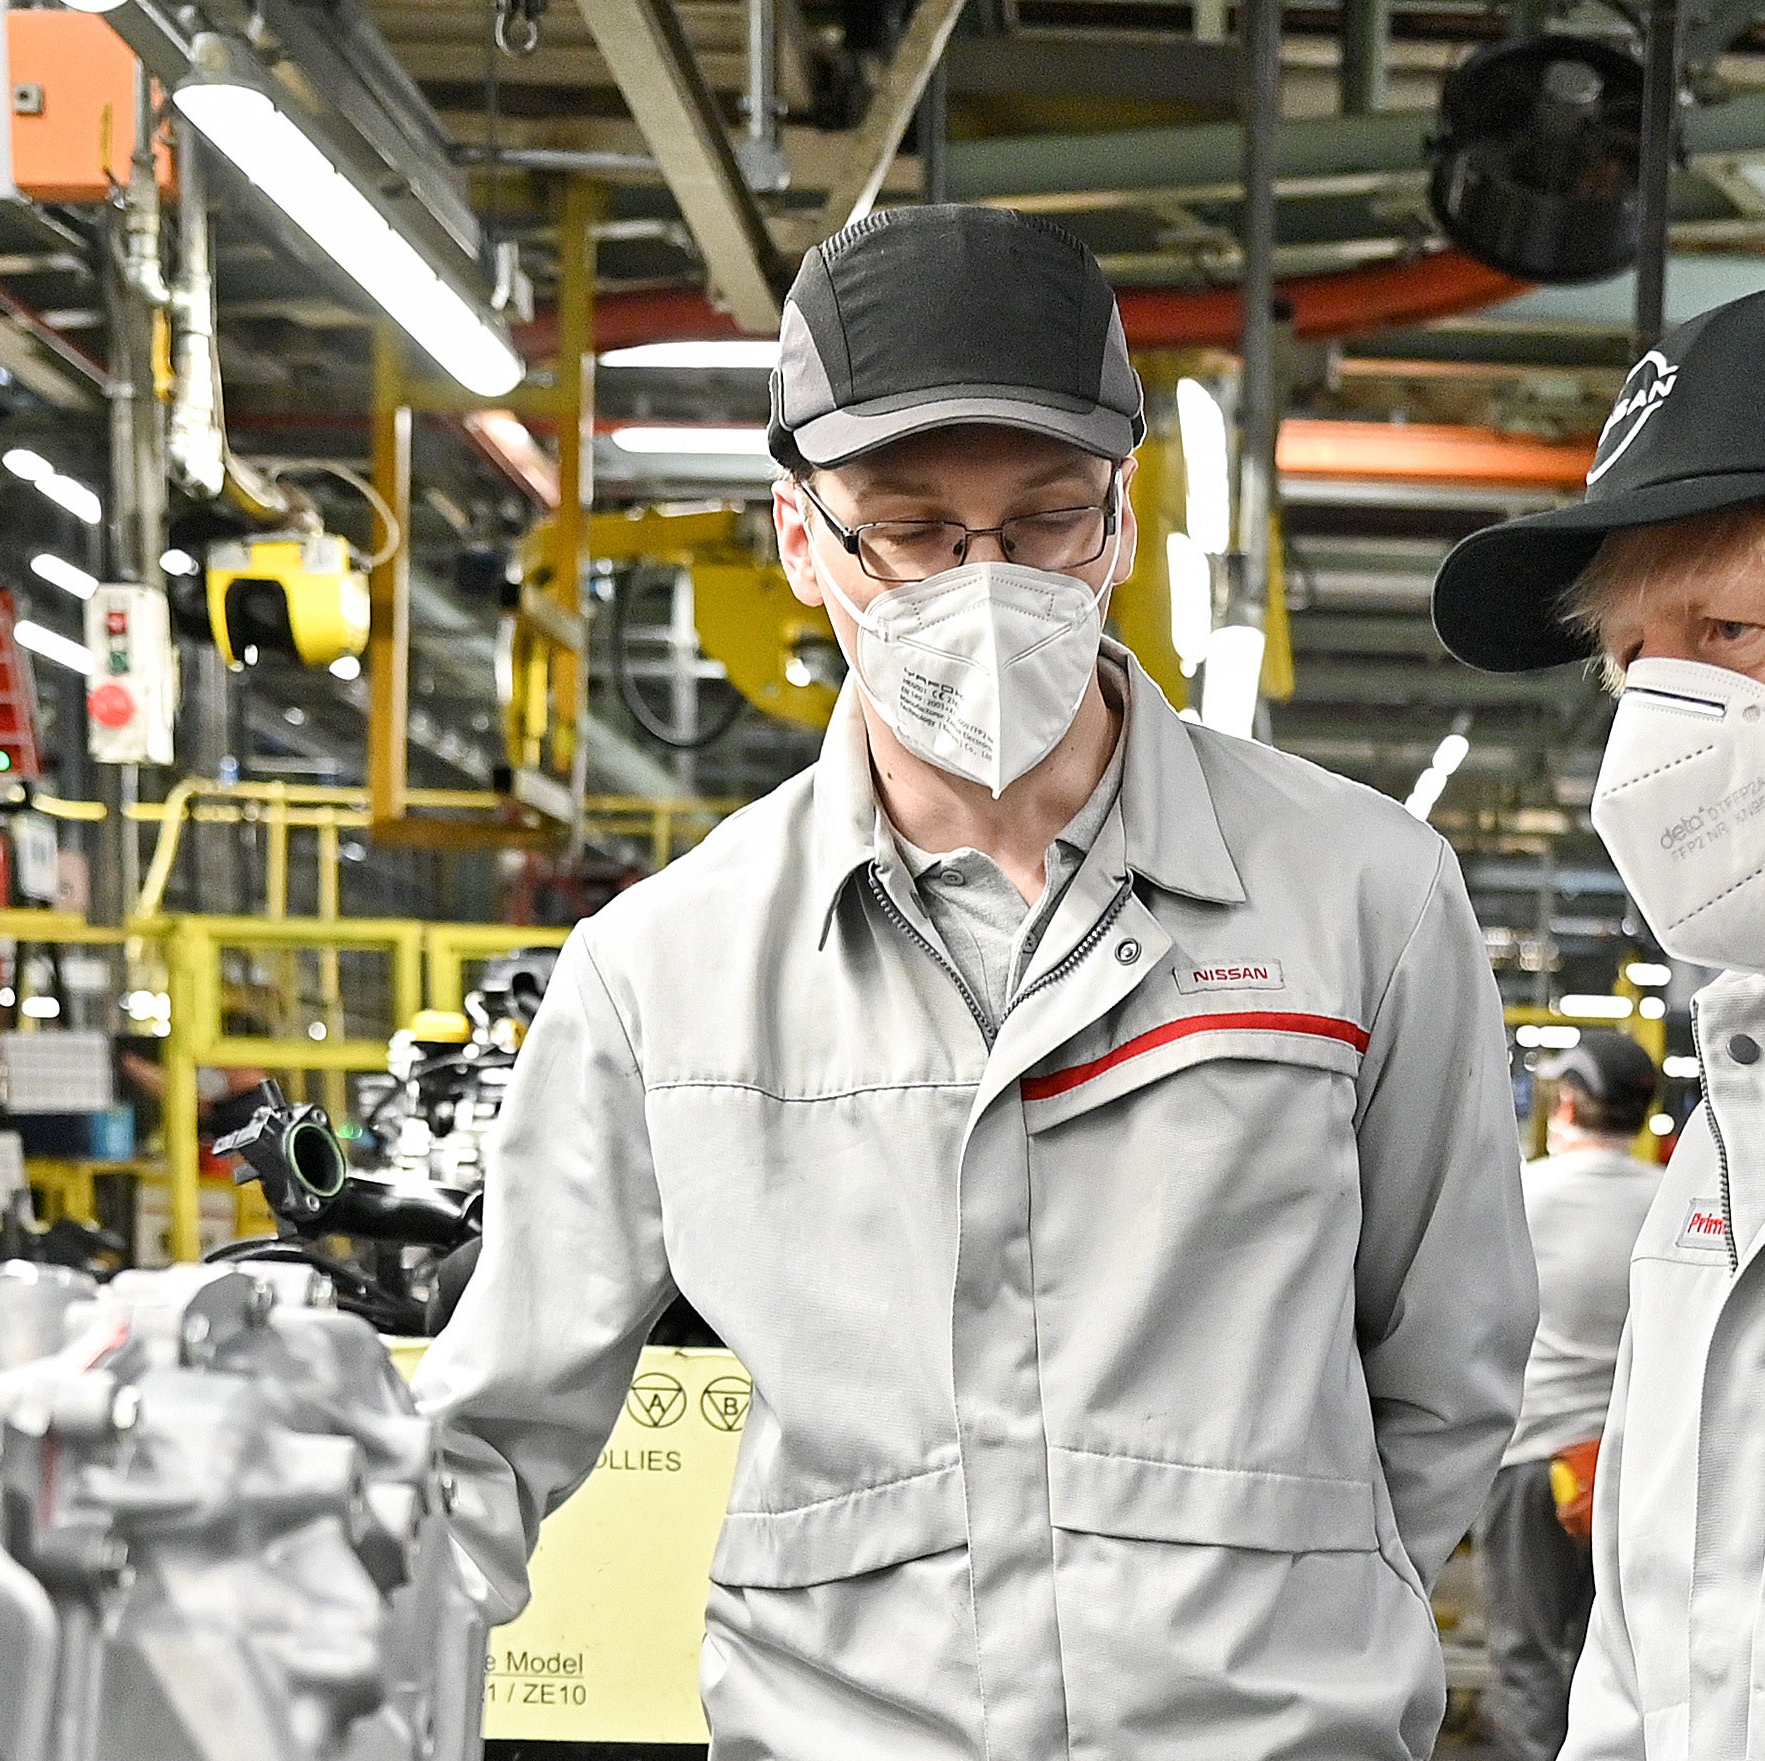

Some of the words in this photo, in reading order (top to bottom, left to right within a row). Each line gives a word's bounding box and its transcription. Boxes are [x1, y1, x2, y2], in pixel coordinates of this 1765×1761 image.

[1193, 966, 1269, 983] NISSAN
[1687, 1212, 1725, 1235] Prim
[649, 1393, 666, 1413] A
[724, 1397, 739, 1416] B
[507, 1651, 583, 1674] Model
[523, 1683, 587, 1705] ZE10
